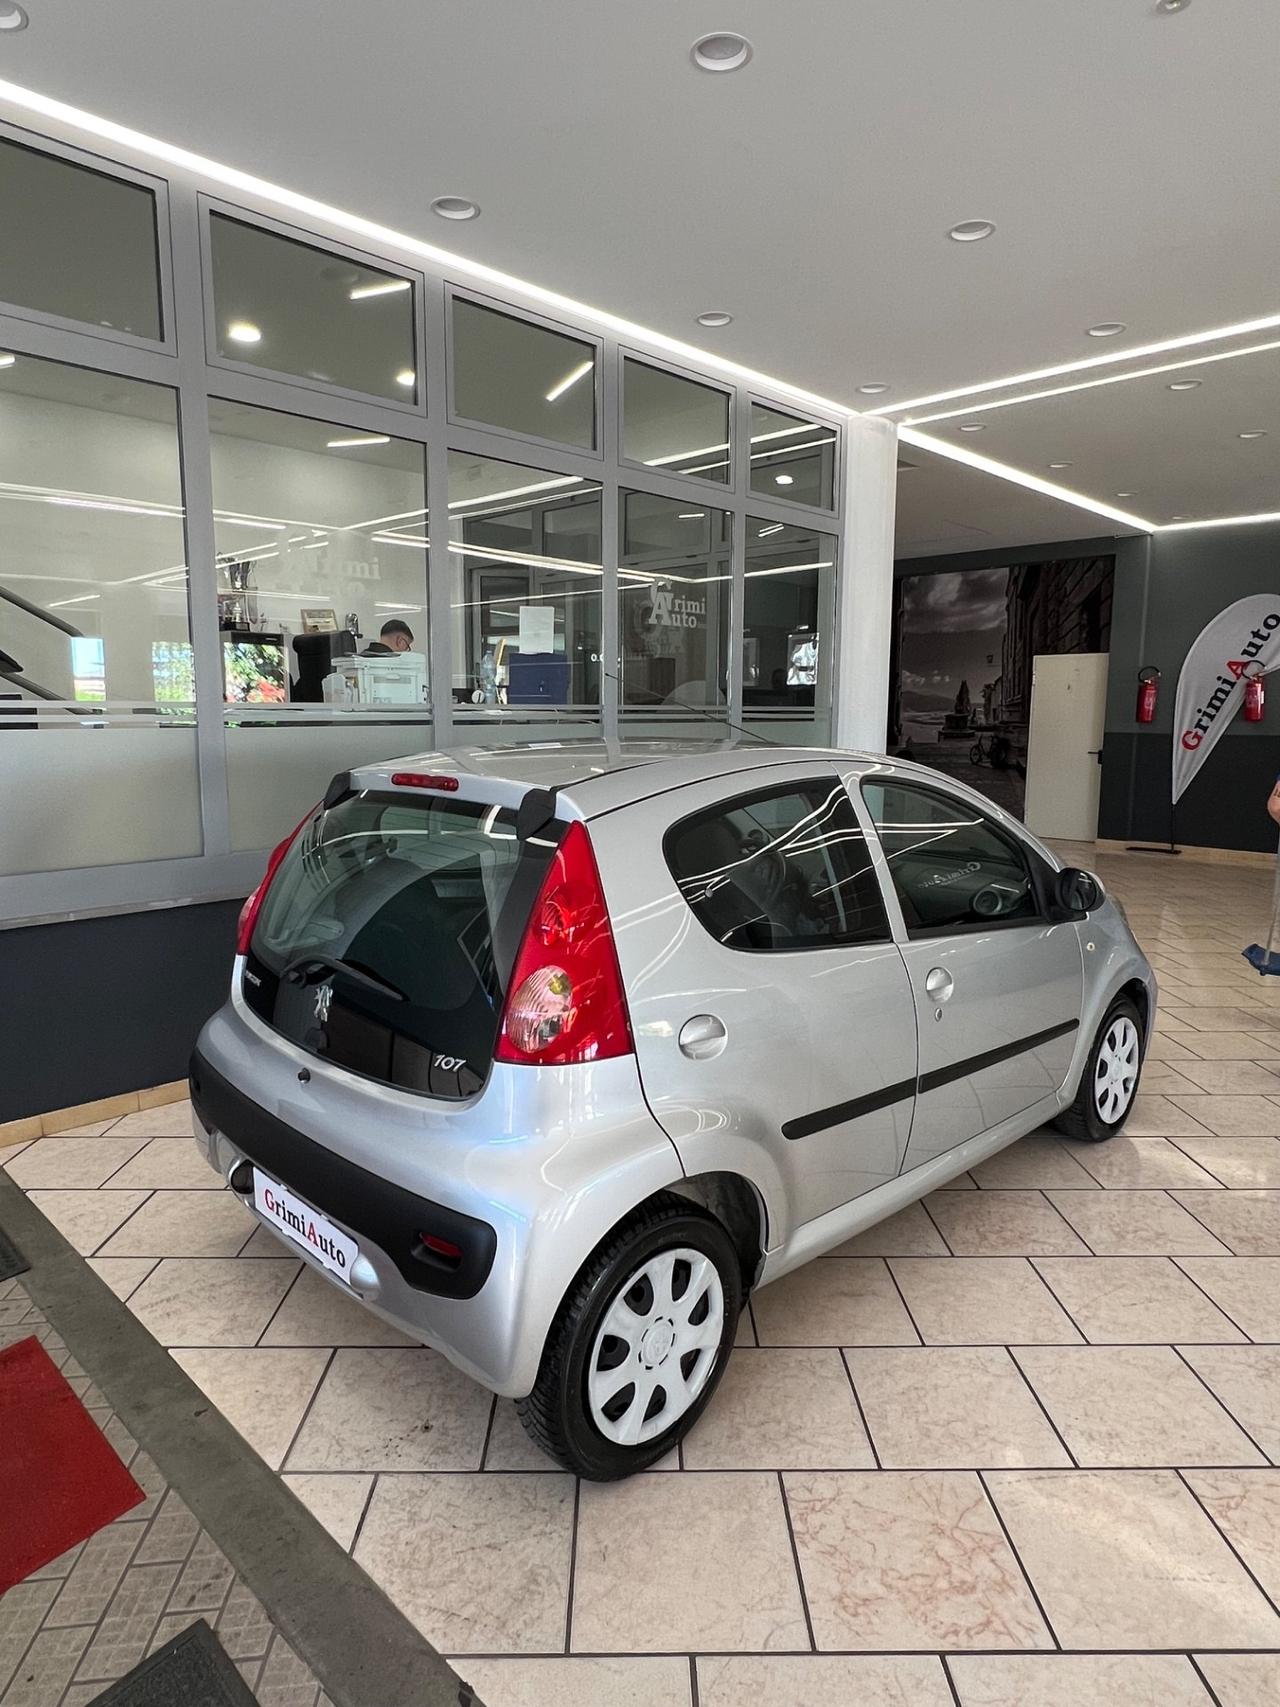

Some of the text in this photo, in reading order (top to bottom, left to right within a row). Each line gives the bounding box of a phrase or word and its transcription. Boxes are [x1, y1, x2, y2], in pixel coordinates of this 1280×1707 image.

[648, 592, 697, 628] Auto
[1181, 613, 1280, 750] GrimiAuto
[434, 1054, 467, 1072] 107
[264, 1188, 346, 1268] GrimiAuto
